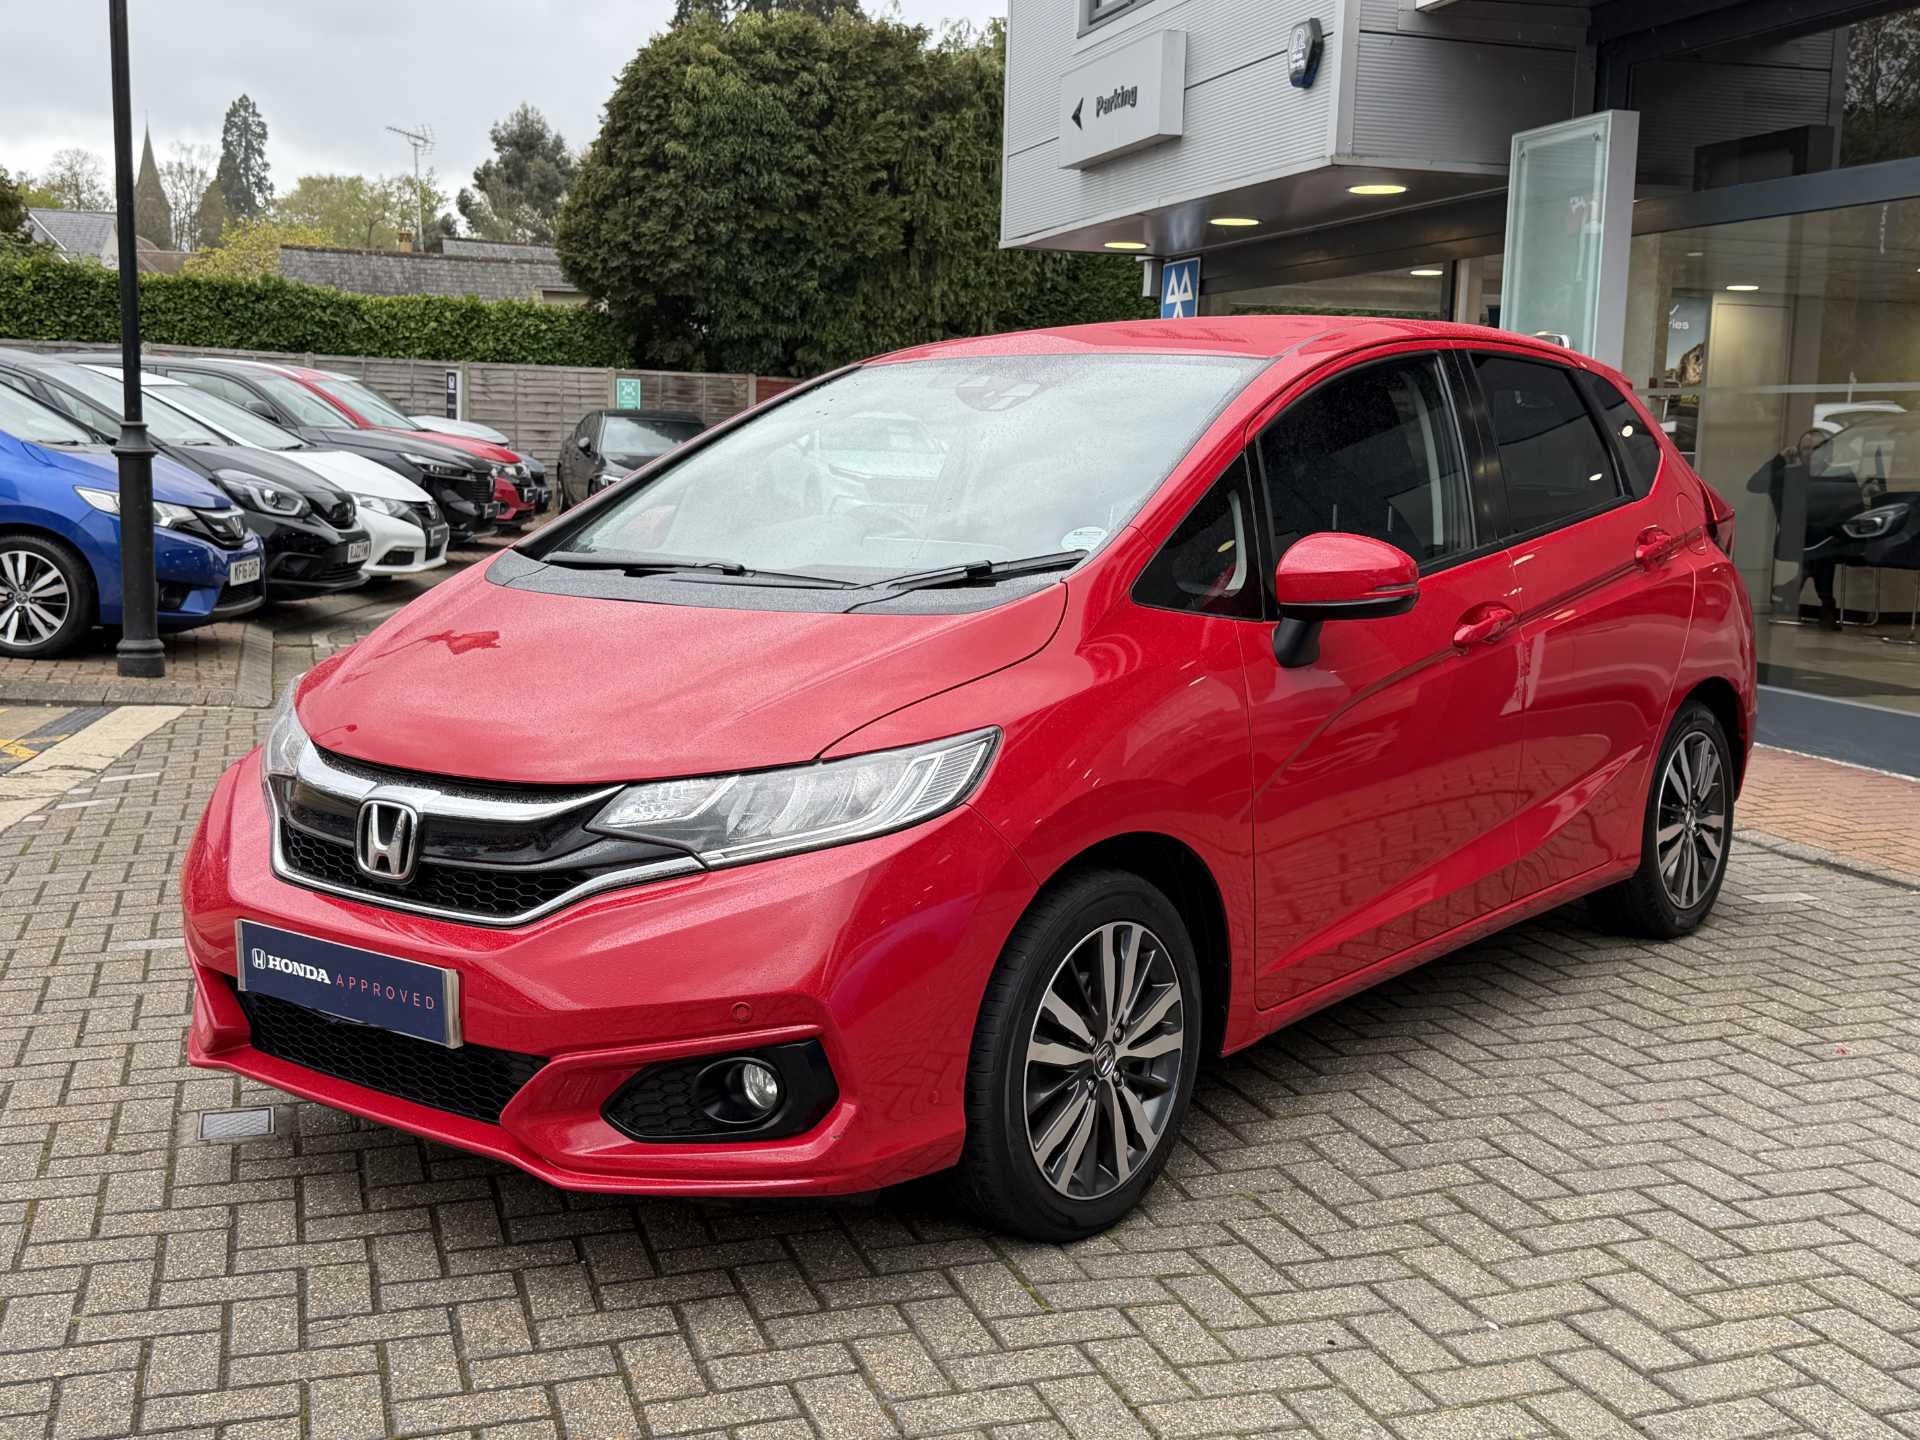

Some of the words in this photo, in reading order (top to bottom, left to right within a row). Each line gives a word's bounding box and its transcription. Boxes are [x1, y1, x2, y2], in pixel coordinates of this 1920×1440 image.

[1096, 85, 1138, 118] Parking
[267, 954, 332, 985] HONDA
[336, 973, 436, 1010] APPROVED
